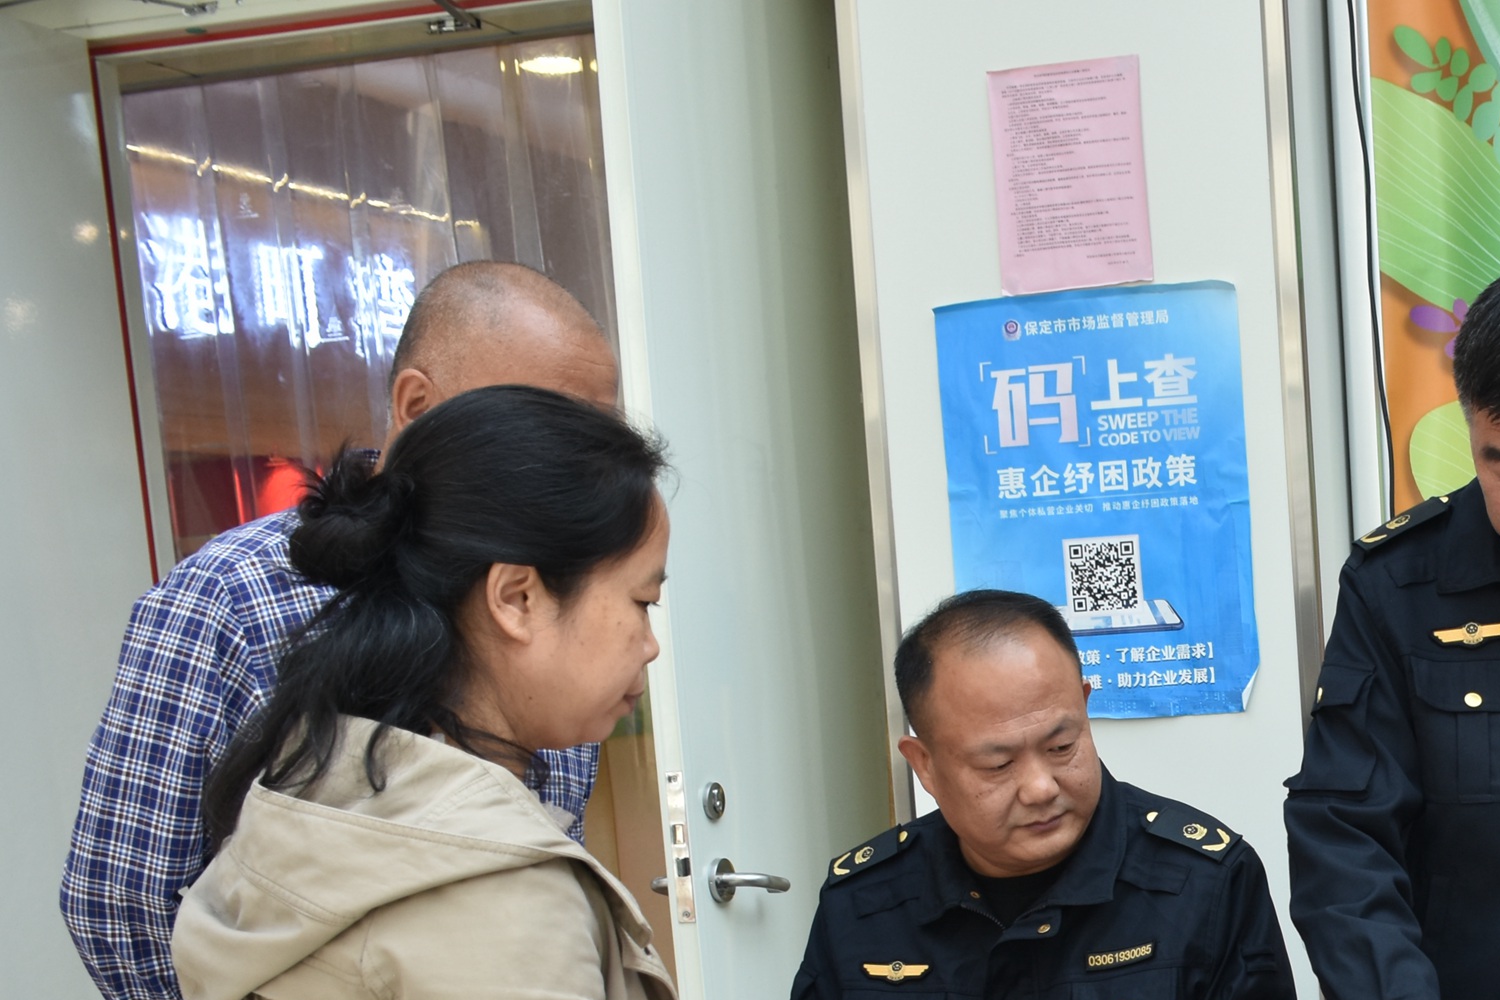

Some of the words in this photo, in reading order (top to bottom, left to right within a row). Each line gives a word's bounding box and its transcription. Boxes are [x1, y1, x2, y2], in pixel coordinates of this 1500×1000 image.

[1024, 309, 1169, 336] 保定市市场监督管理局
[1097, 411, 1159, 431] SWEEP
[1162, 407, 1198, 425] THE
[1098, 429, 1139, 447] CODE
[1140, 429, 1161, 443] TO
[1162, 426, 1200, 441] VIEW
[997, 454, 1198, 500] 惠企纾困政策
[1102, 495, 1199, 512] 推动惠企纾困政策落地
[1082, 667, 1216, 690] 难·助力企业发展】
[1088, 943, 1152, 967] 03061930085
